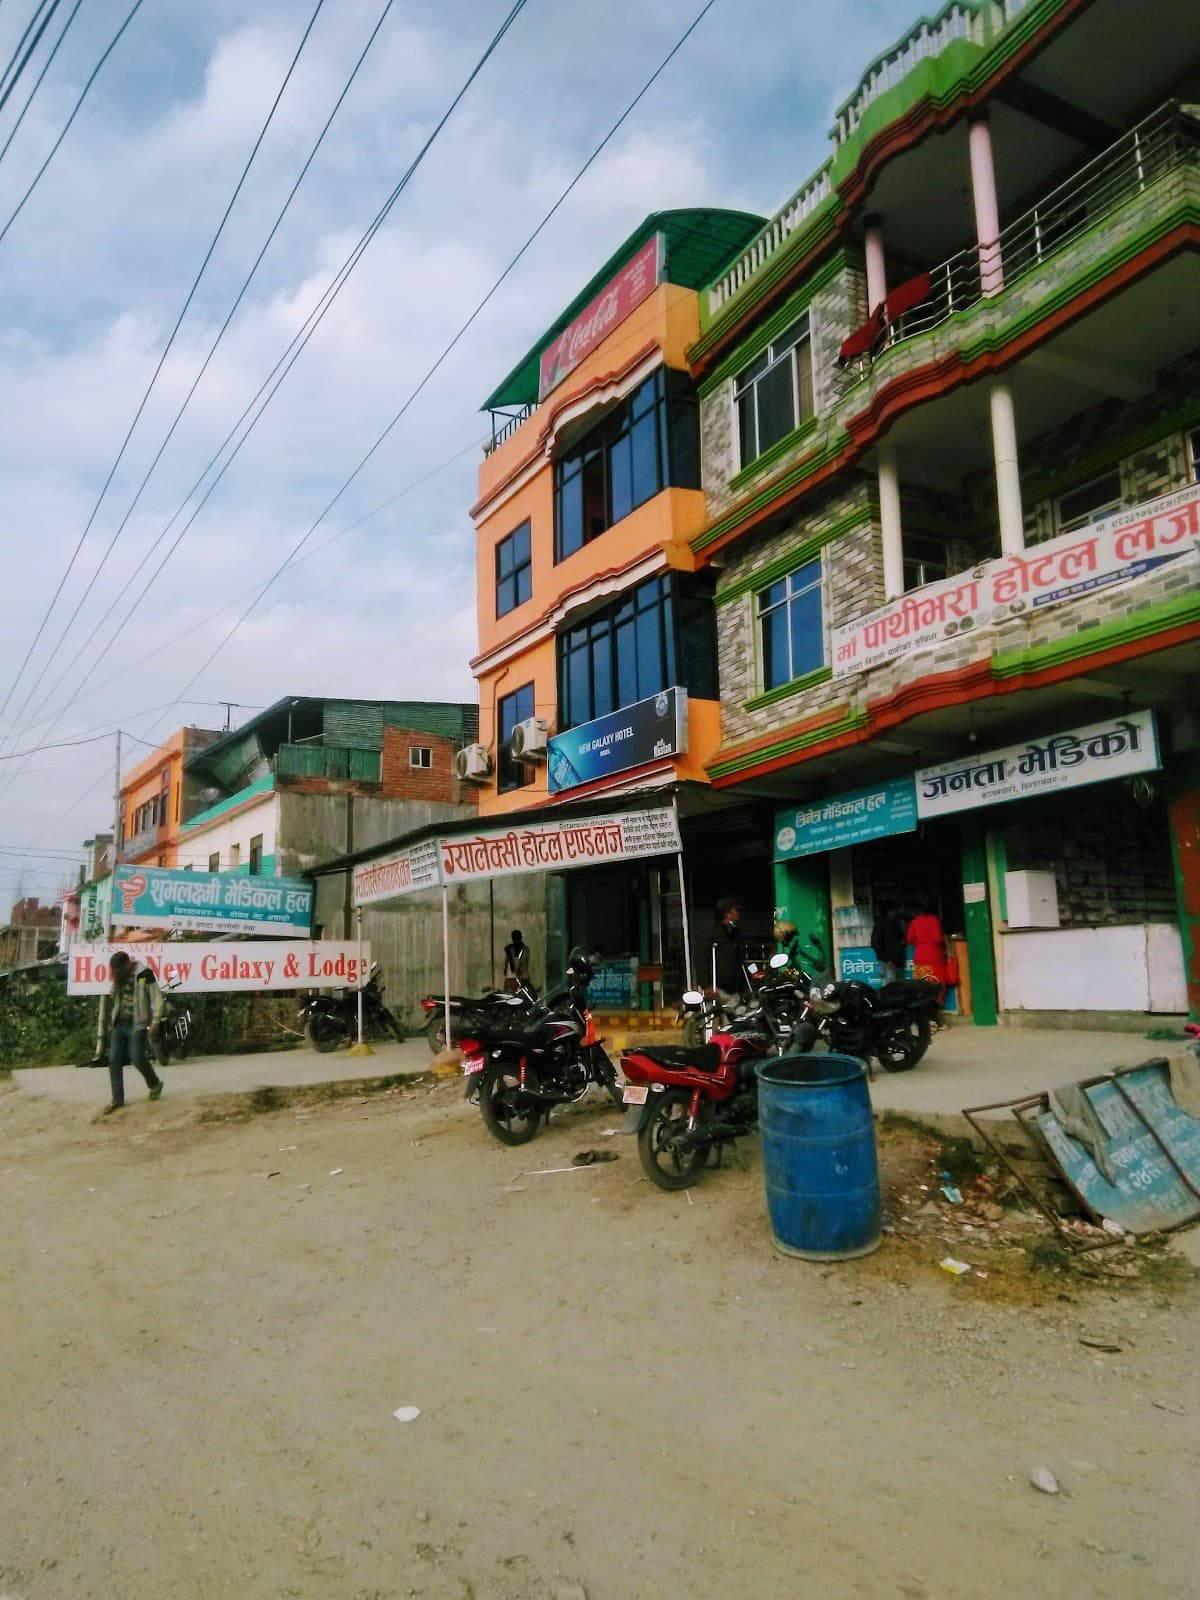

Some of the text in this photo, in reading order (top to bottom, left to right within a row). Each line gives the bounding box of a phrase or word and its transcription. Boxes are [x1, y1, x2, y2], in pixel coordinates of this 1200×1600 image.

[864, 579, 983, 649] पाथीभरा
[992, 536, 1100, 603] होटल
[578, 741, 592, 755] NEW
[592, 733, 615, 750] GALAXY
[614, 726, 634, 742] HOTEL
[922, 759, 1007, 801] जनता
[1017, 720, 1145, 777] मेडिको
[822, 797, 865, 820] मेडिकल
[521, 830, 564, 867] होटल
[225, 879, 282, 910] मेडिकल
[285, 891, 312, 913] हल
[145, 955, 193, 982] New
[200, 954, 275, 985] Galaxy
[283, 953, 300, 979] &
[308, 952, 369, 983] Lodge
